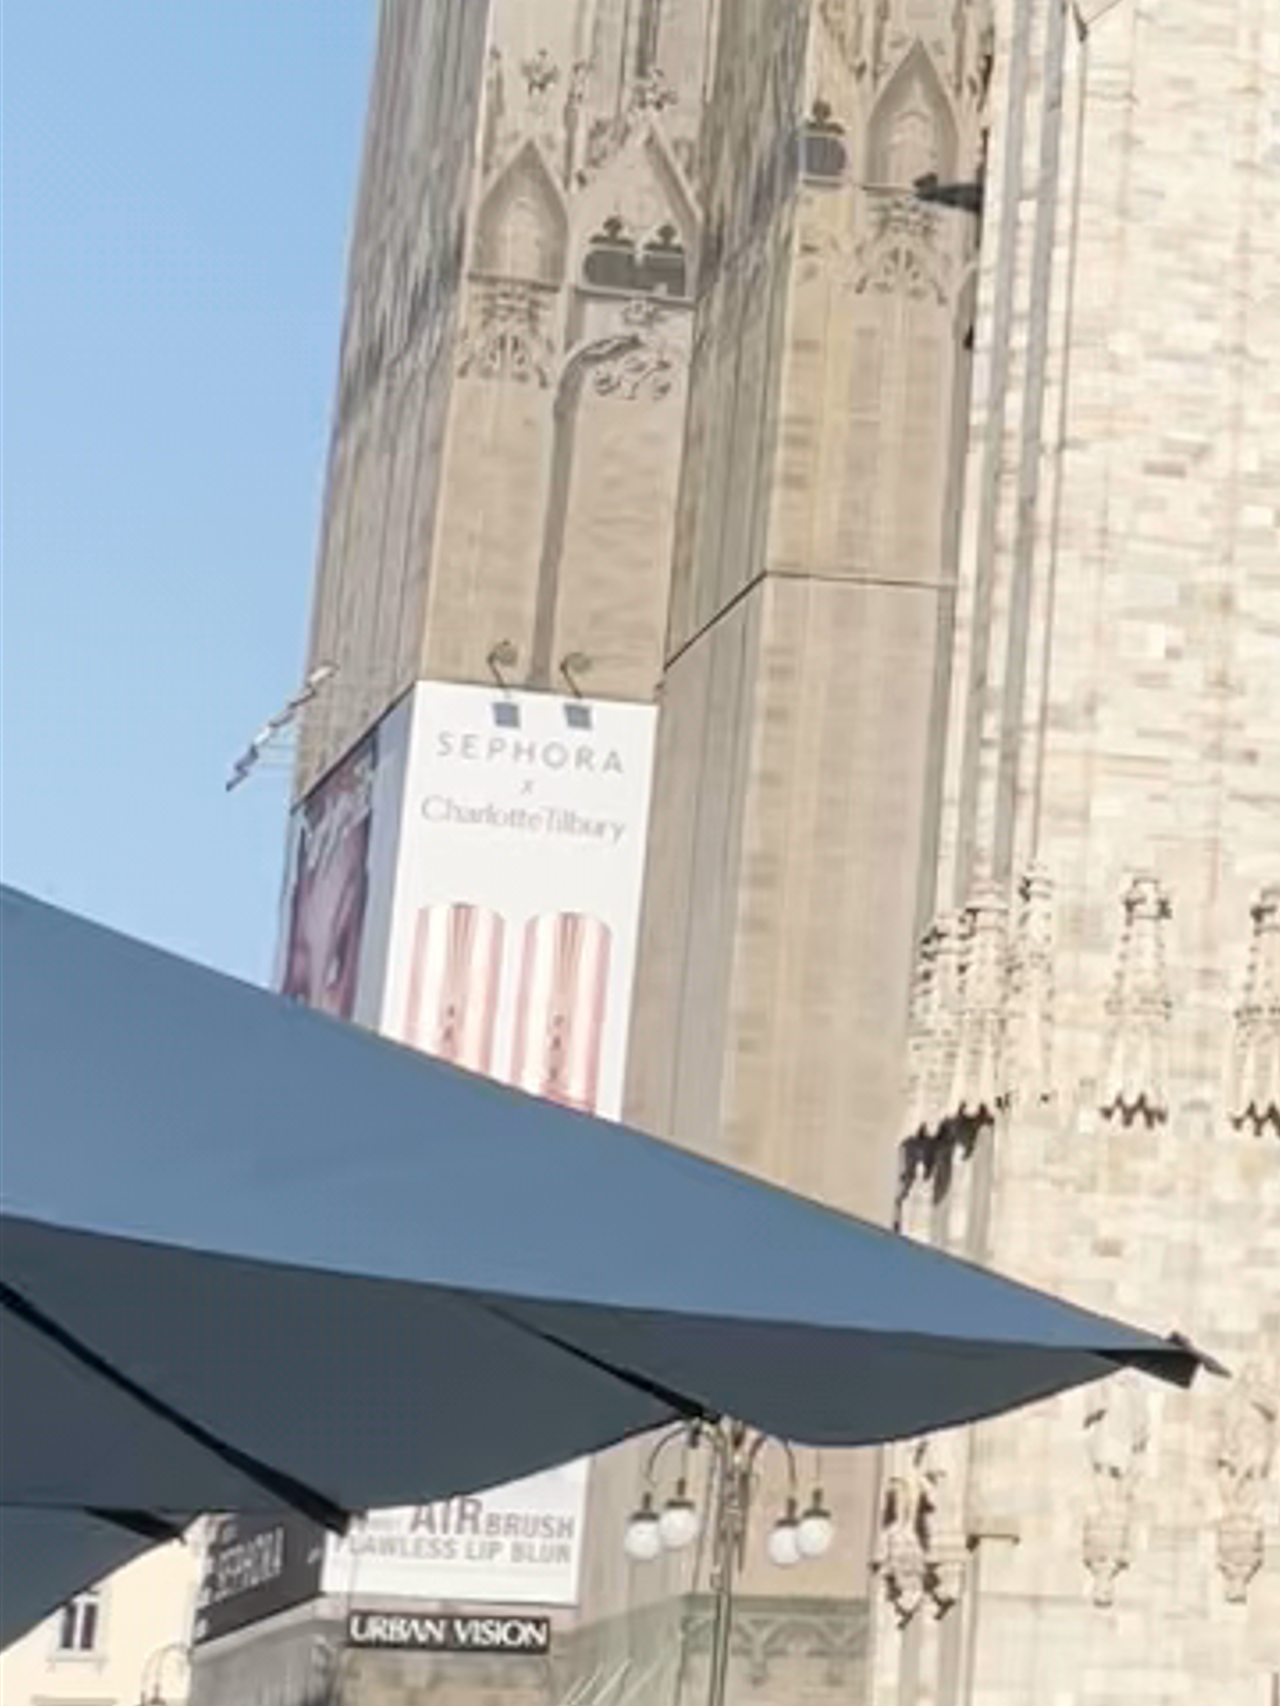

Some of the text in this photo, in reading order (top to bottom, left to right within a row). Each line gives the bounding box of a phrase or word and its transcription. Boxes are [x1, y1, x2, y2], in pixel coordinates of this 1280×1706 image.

[436, 731, 623, 774] SEPHORA
[421, 794, 625, 844] Charlotte Tilbury
[410, 1496, 575, 1539] AIRBRUSH
[464, 1540, 504, 1561] LIP
[349, 1616, 549, 1646] URBAN VISION
